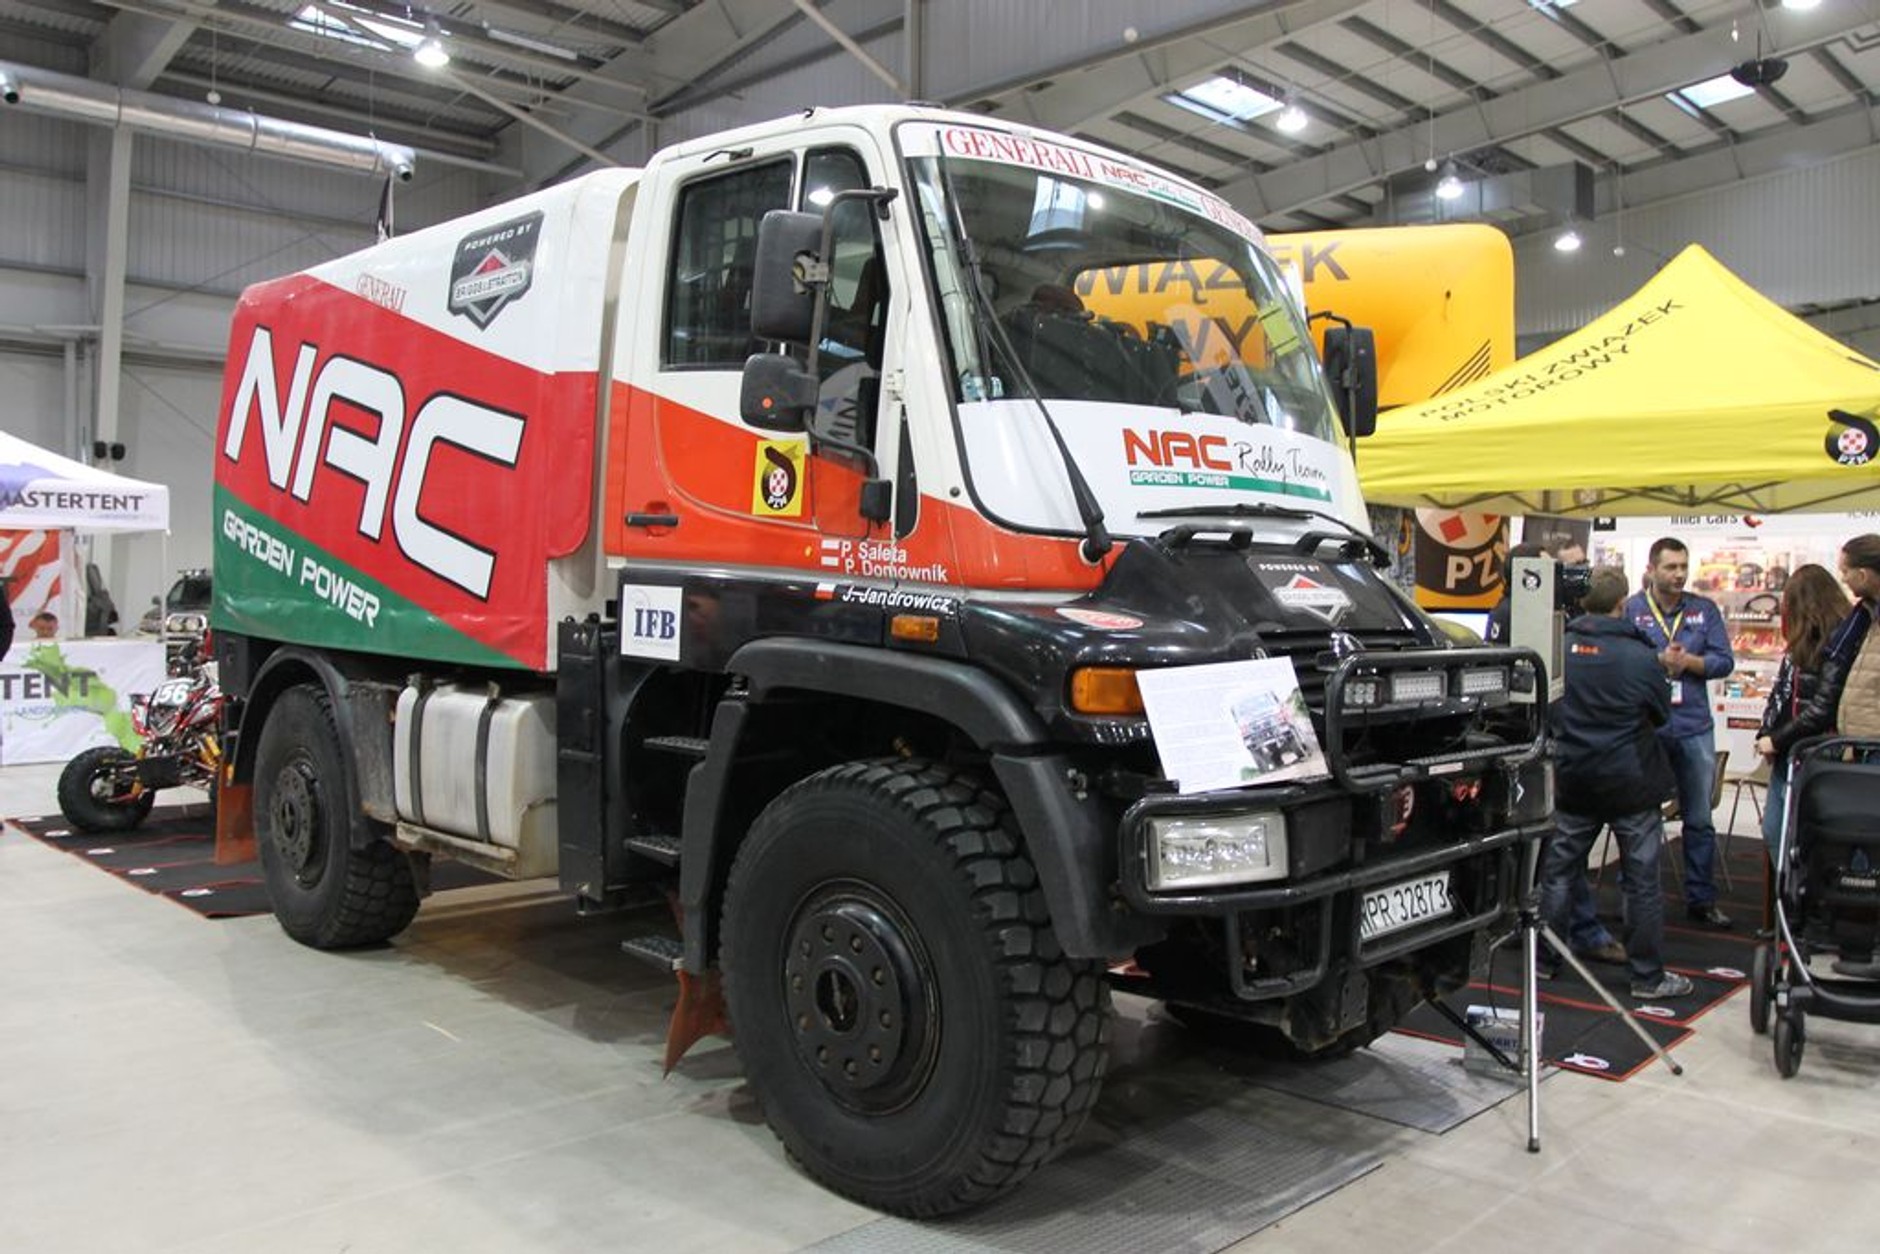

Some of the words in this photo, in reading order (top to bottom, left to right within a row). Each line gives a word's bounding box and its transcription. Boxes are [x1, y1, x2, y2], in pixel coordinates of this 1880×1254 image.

[945, 128, 1095, 178] GENERALI
[516, 222, 532, 236] BY
[1440, 344, 1630, 422] MOTOROWY
[223, 324, 527, 602] NAC
[1122, 428, 1233, 471] NAC
[1233, 441, 1287, 495] Rally
[1130, 471, 1183, 484] GARDEN
[1187, 473, 1230, 487] POWER
[841, 541, 854, 558] P.
[223, 508, 295, 578] GARDEN
[300, 556, 380, 629] POWER
[845, 559, 859, 575] P.
[862, 560, 949, 583] Domownik
[633, 607, 676, 640] IFB
[0, 671, 98, 700] TENT
[1393, 879, 1448, 921] 32873
